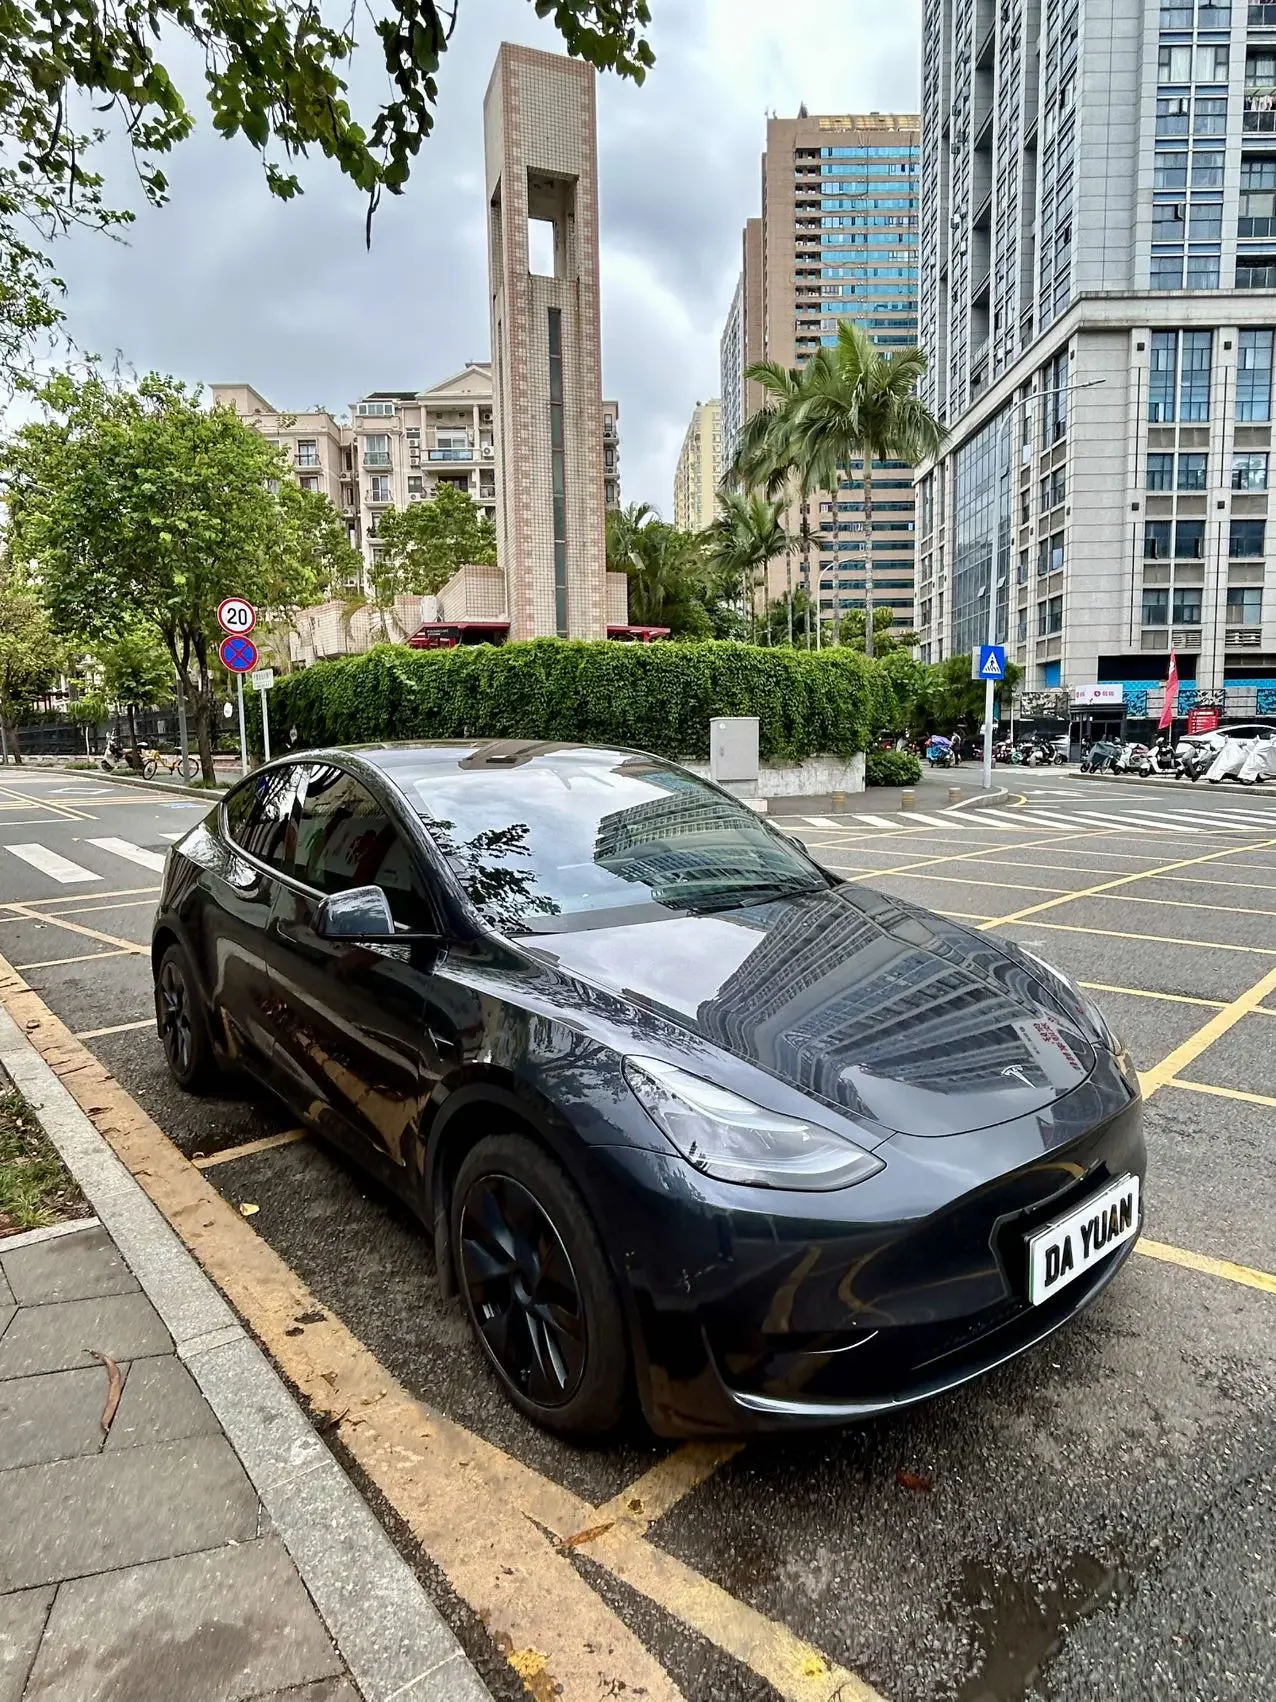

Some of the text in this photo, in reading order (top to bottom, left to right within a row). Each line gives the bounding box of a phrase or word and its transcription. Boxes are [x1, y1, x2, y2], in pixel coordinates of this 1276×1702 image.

[227, 607, 247, 625] 20
[1044, 1192, 1132, 1287] DA YUAN
